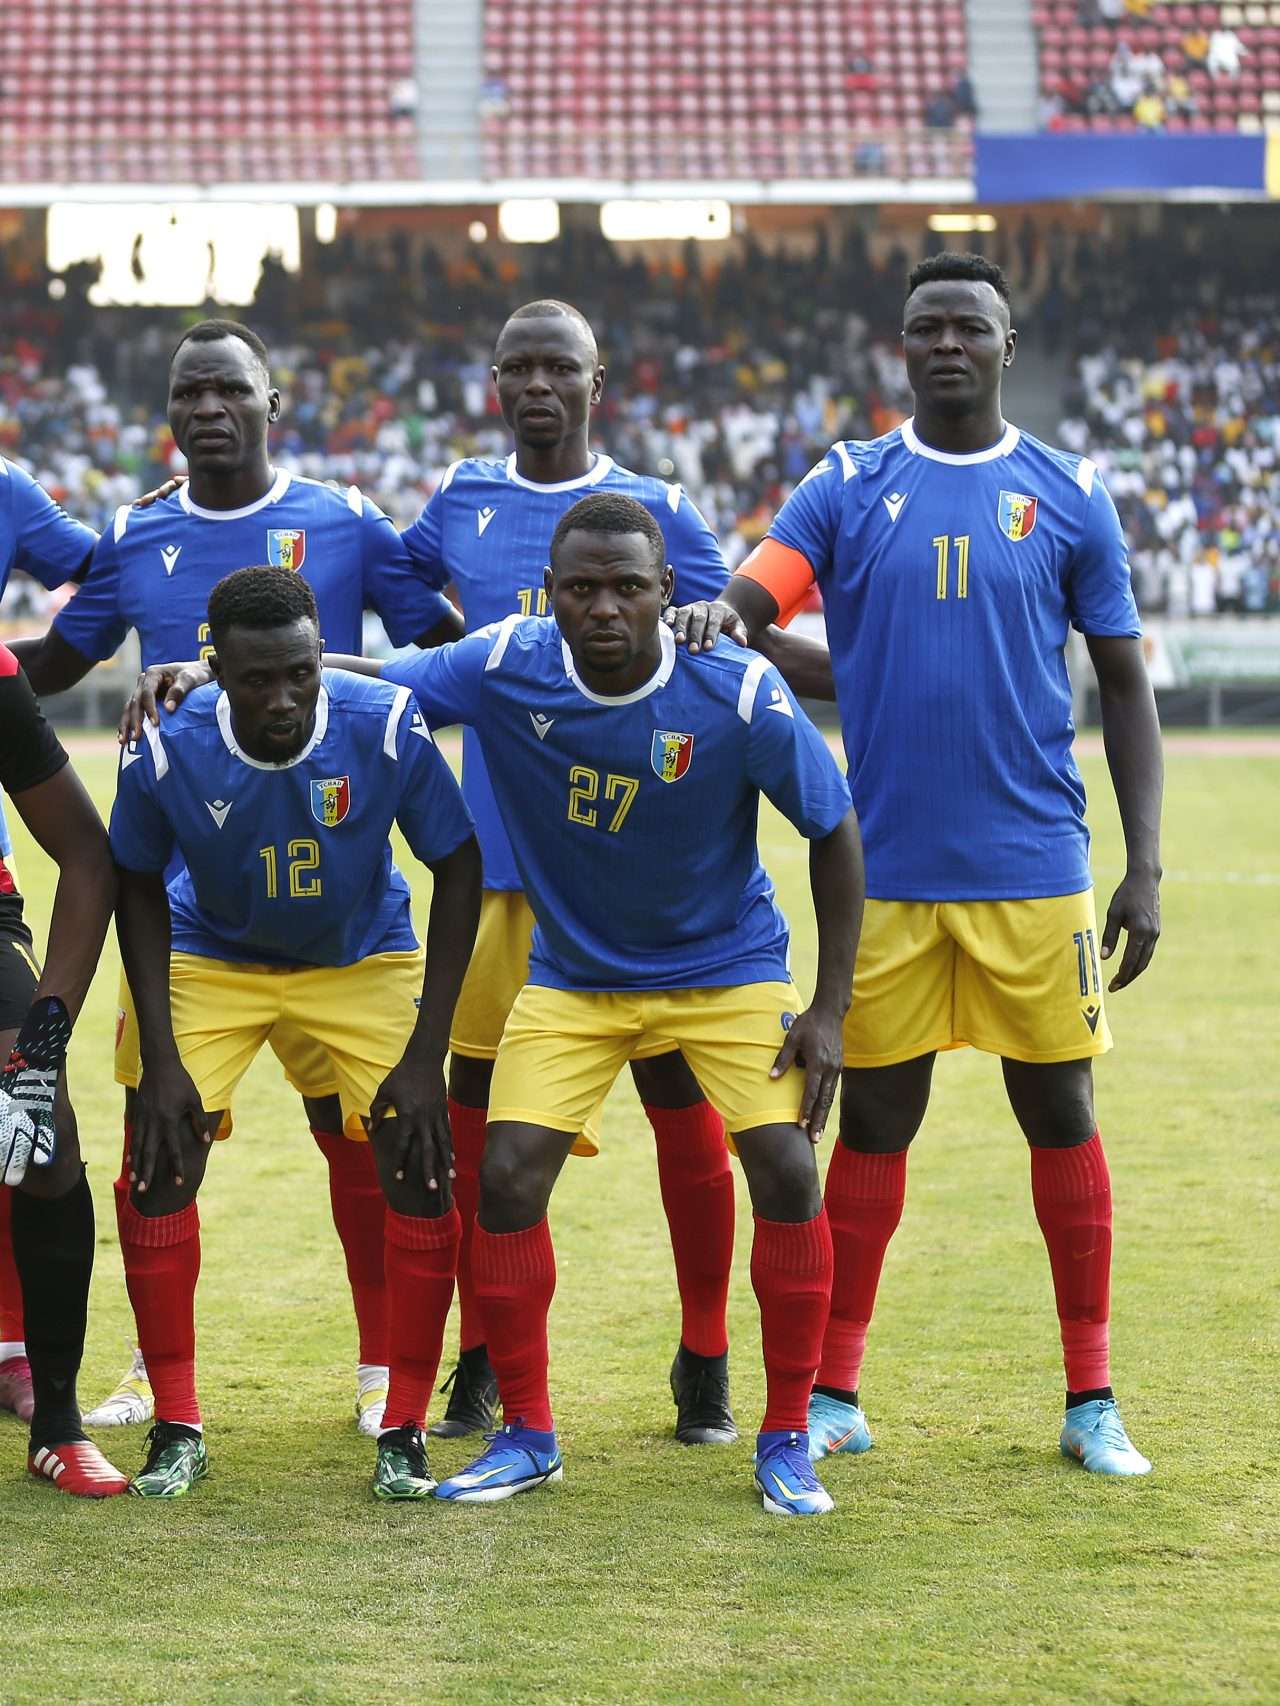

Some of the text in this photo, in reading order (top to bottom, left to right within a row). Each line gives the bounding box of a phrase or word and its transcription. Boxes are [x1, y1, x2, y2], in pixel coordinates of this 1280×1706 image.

[932, 535, 970, 600] 11
[662, 734, 687, 744] TCHAD
[319, 780, 343, 789] TCHAD
[568, 766, 640, 832] 27
[260, 839, 322, 898] 12
[1073, 929, 1100, 997] 11
